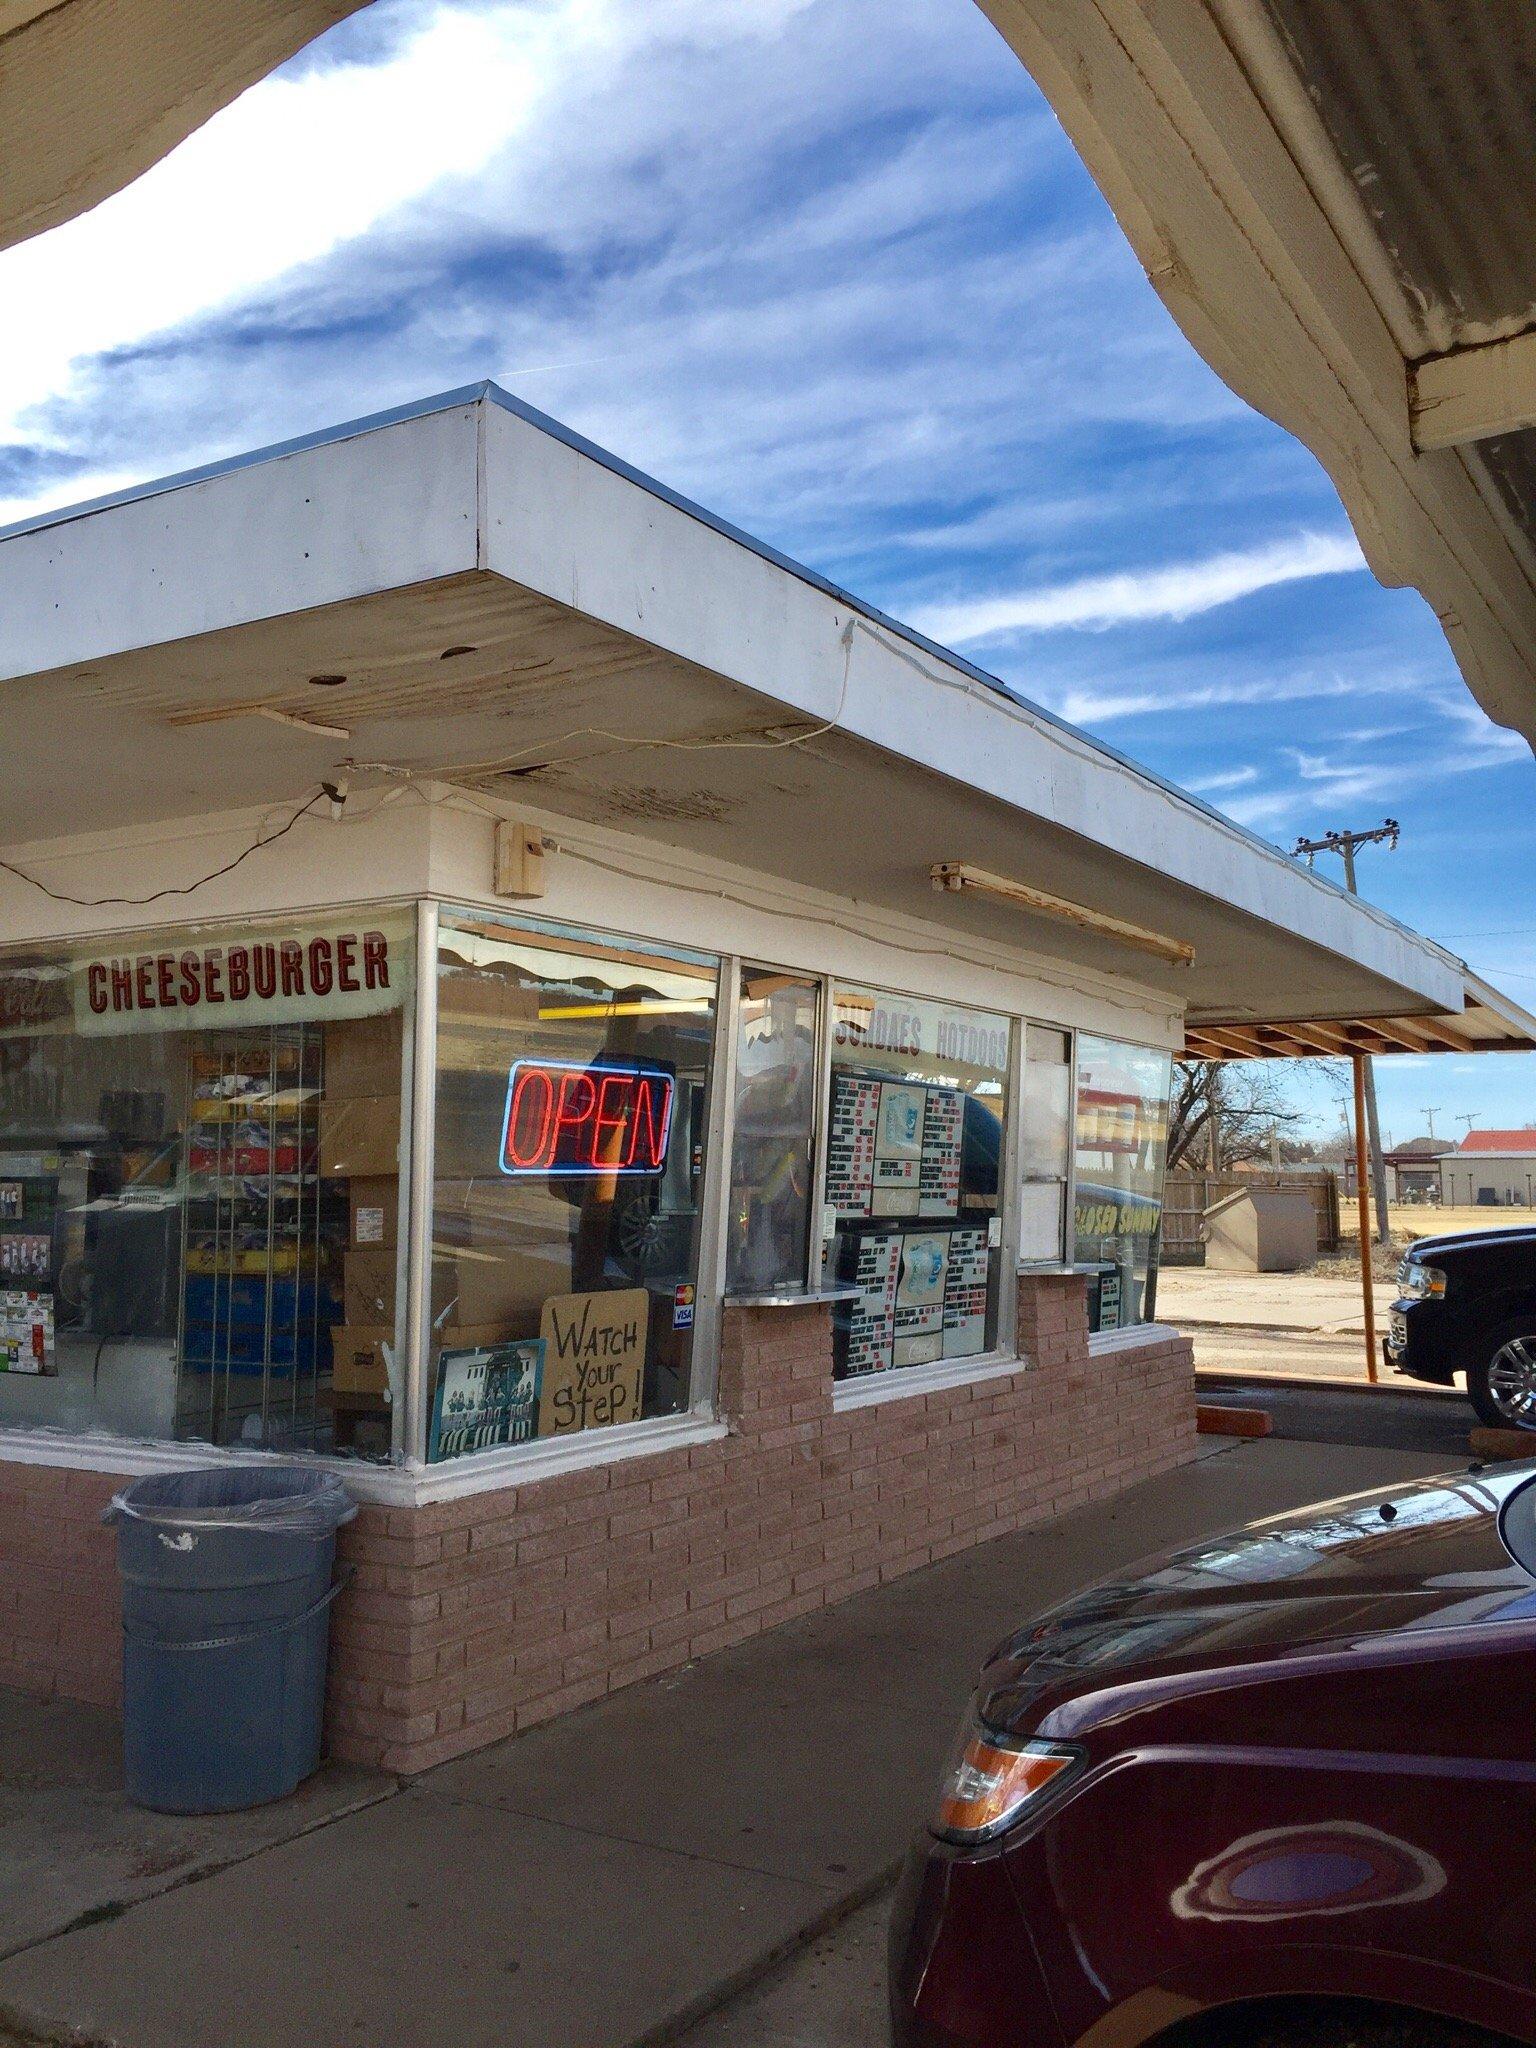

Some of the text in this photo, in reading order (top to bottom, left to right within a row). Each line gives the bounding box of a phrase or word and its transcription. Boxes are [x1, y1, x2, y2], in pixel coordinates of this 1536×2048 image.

[88, 931, 391, 1014] CHEESEBURGER
[936, 1018, 1008, 1070] HOTDOGS
[508, 1069, 673, 1168] OPEN
[676, 1308, 692, 1320] VISA
